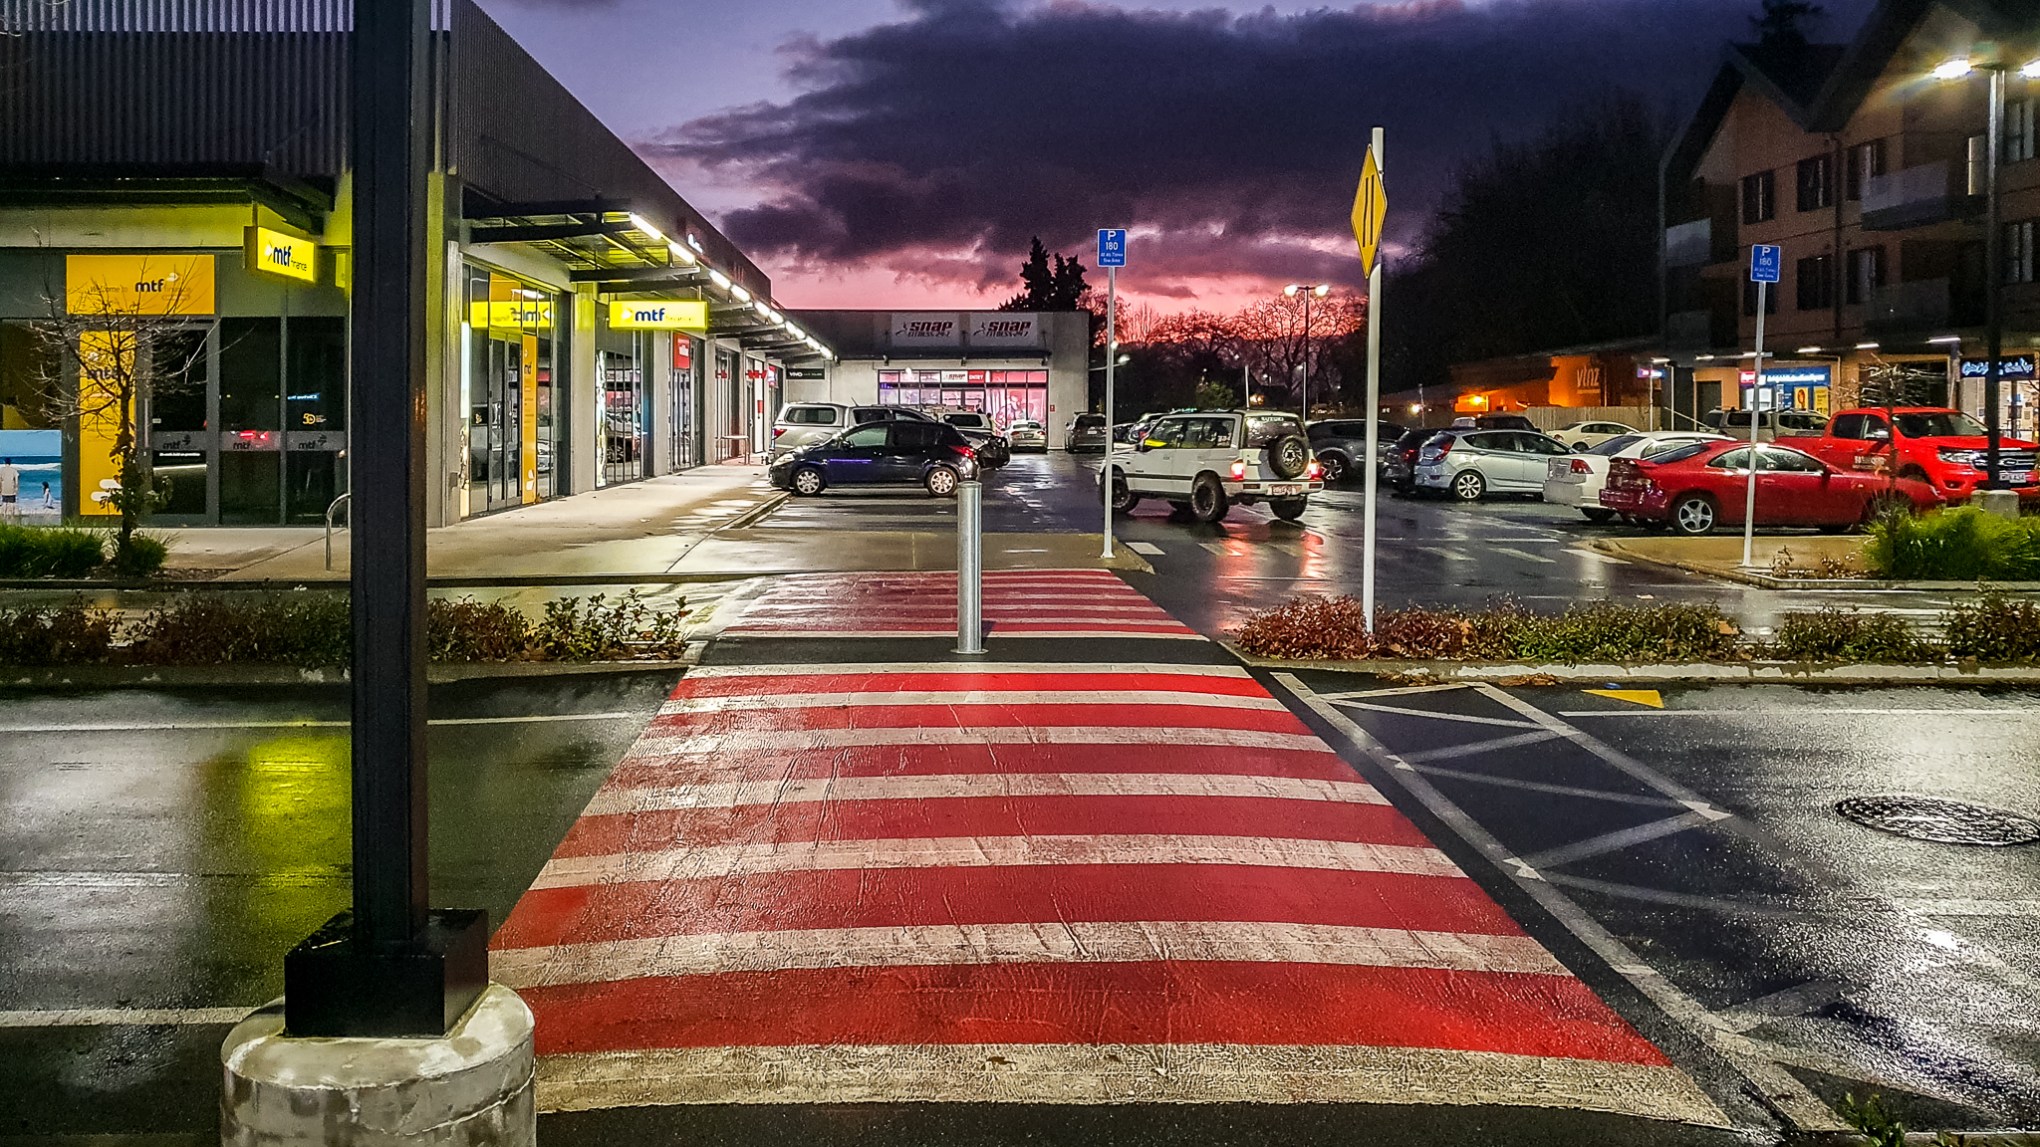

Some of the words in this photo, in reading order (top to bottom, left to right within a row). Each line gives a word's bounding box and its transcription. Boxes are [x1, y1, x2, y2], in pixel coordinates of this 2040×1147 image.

[1107, 230, 1116, 240] P
[1105, 242, 1118, 250] 180
[1762, 247, 1770, 256] P
[273, 245, 292, 267] mtf
[1760, 257, 1772, 266] 180
[135, 279, 164, 292] mtf
[635, 308, 665, 321] mtf
[909, 321, 953, 332] snap
[987, 321, 1031, 332] snap
